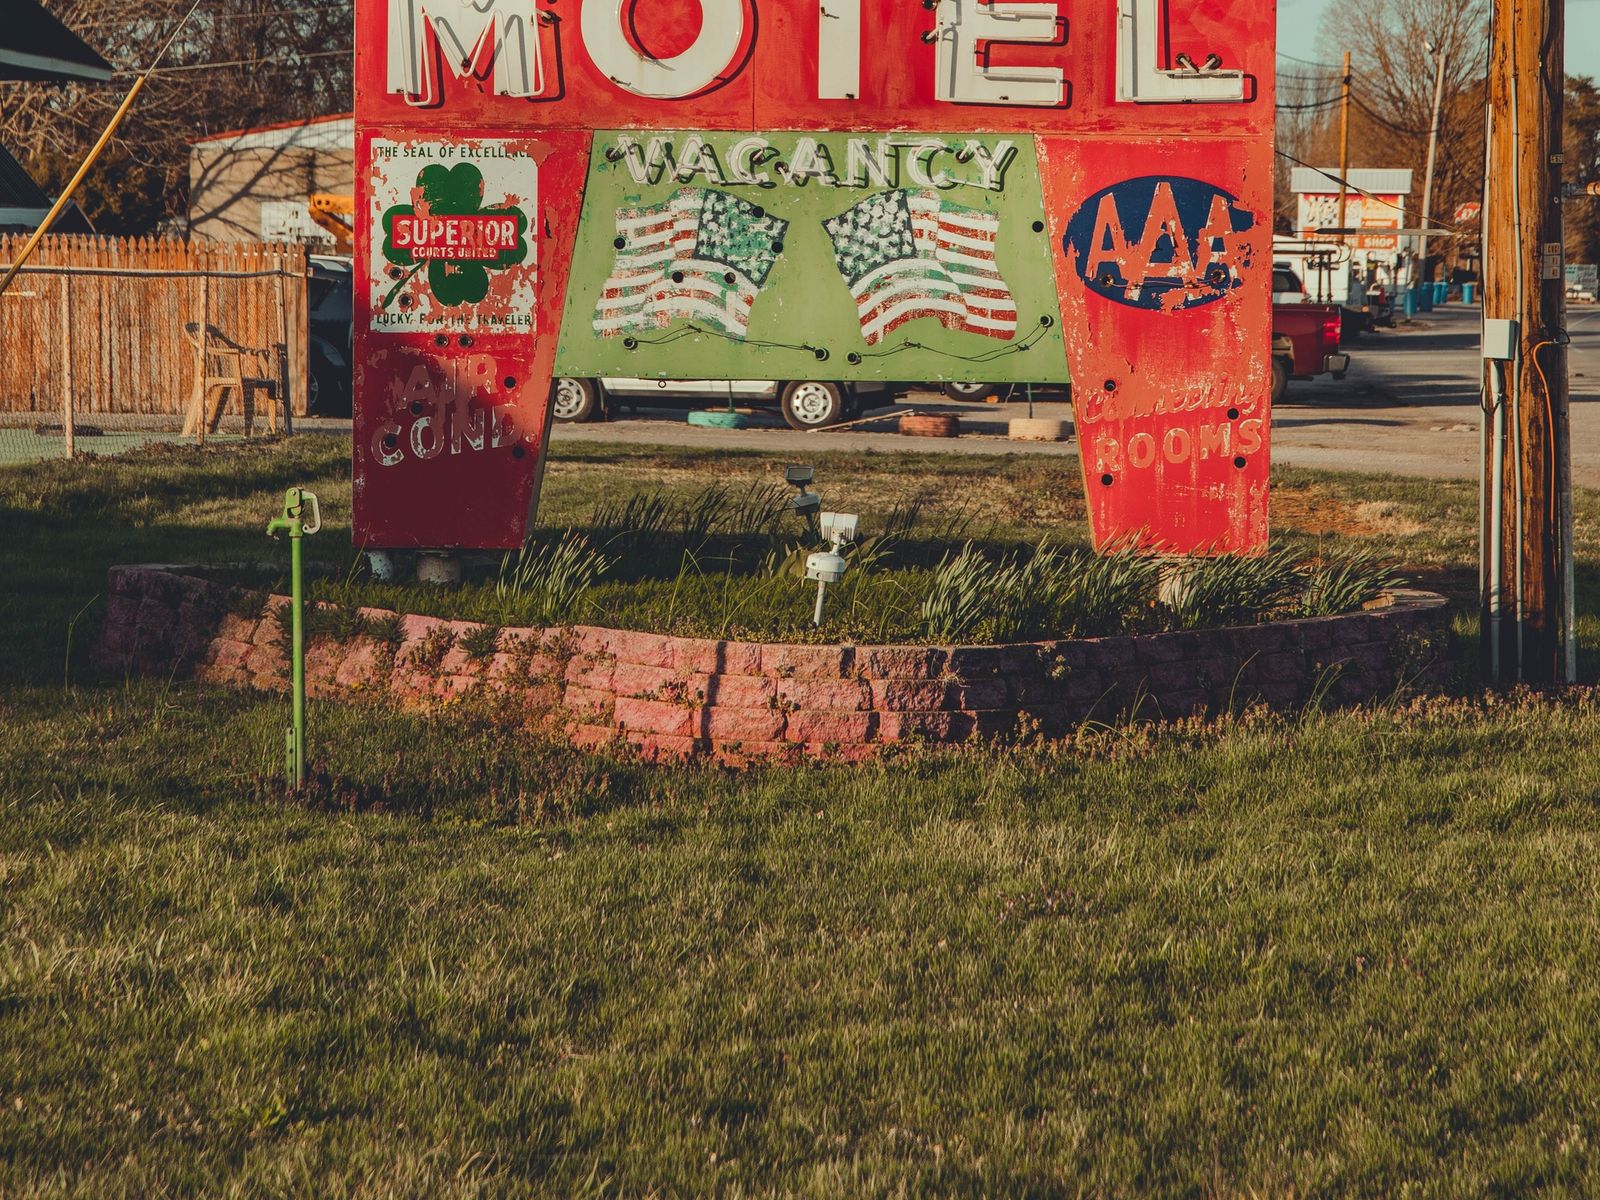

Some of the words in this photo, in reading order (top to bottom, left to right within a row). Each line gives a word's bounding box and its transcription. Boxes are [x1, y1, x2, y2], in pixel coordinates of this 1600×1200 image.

[377, 146, 399, 158] THE
[403, 146, 433, 158] SEAL
[439, 146, 454, 158] OF
[616, 135, 1017, 189] VACANCY
[397, 219, 516, 247] SUPERIOR
[412, 246, 454, 258] COURTS
[458, 246, 497, 258] UNITED
[1085, 181, 1238, 302] AAA
[376, 313, 411, 326] LUCKY
[403, 353, 498, 409] AIR
[1095, 418, 1263, 473] ROOMS
